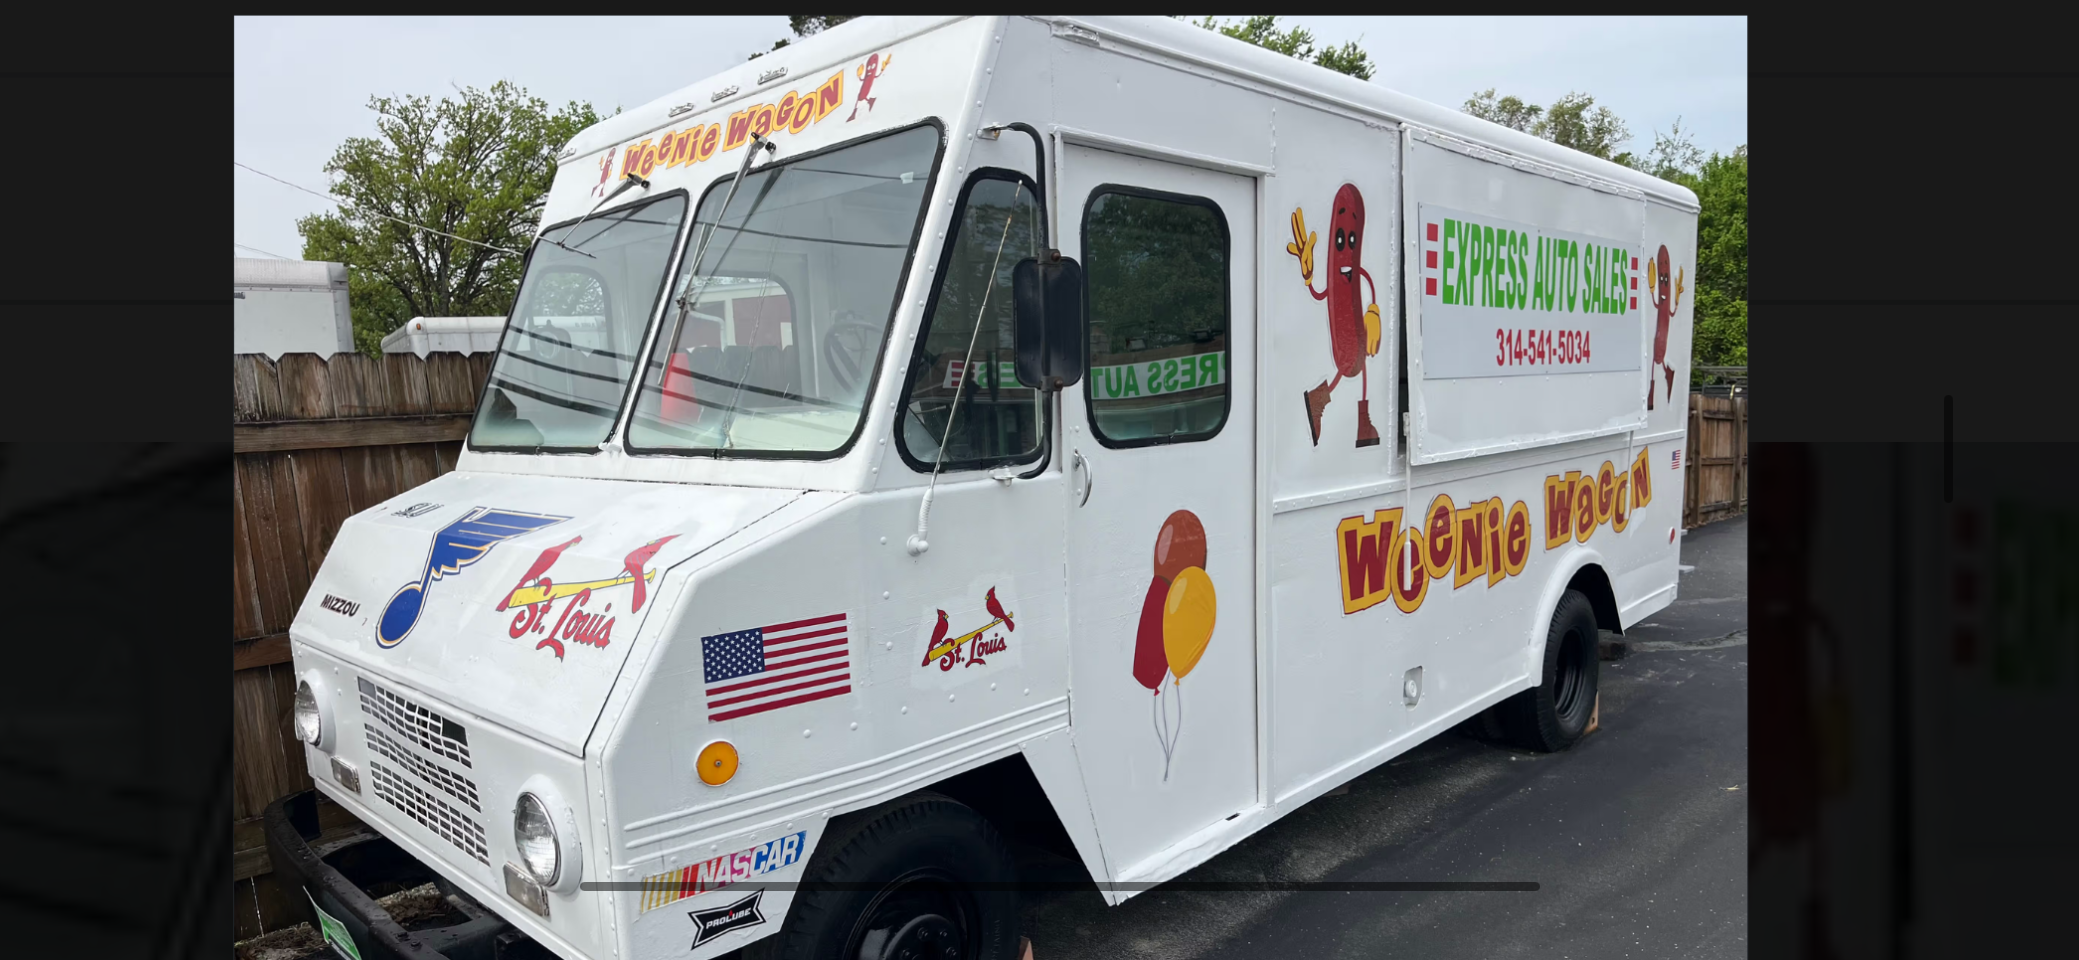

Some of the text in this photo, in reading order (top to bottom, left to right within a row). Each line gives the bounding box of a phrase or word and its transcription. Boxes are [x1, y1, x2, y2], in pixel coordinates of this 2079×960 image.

[1442, 218, 1628, 316] EXPRESS AUTO SALES
[1496, 328, 1591, 366] 314-541-5034
[320, 593, 361, 617] MIZZOU
[509, 577, 616, 662] St. Louis
[940, 632, 1007, 671] St. Louis
[699, 832, 800, 893] NASCAR
[705, 907, 752, 930] PROLUBE
